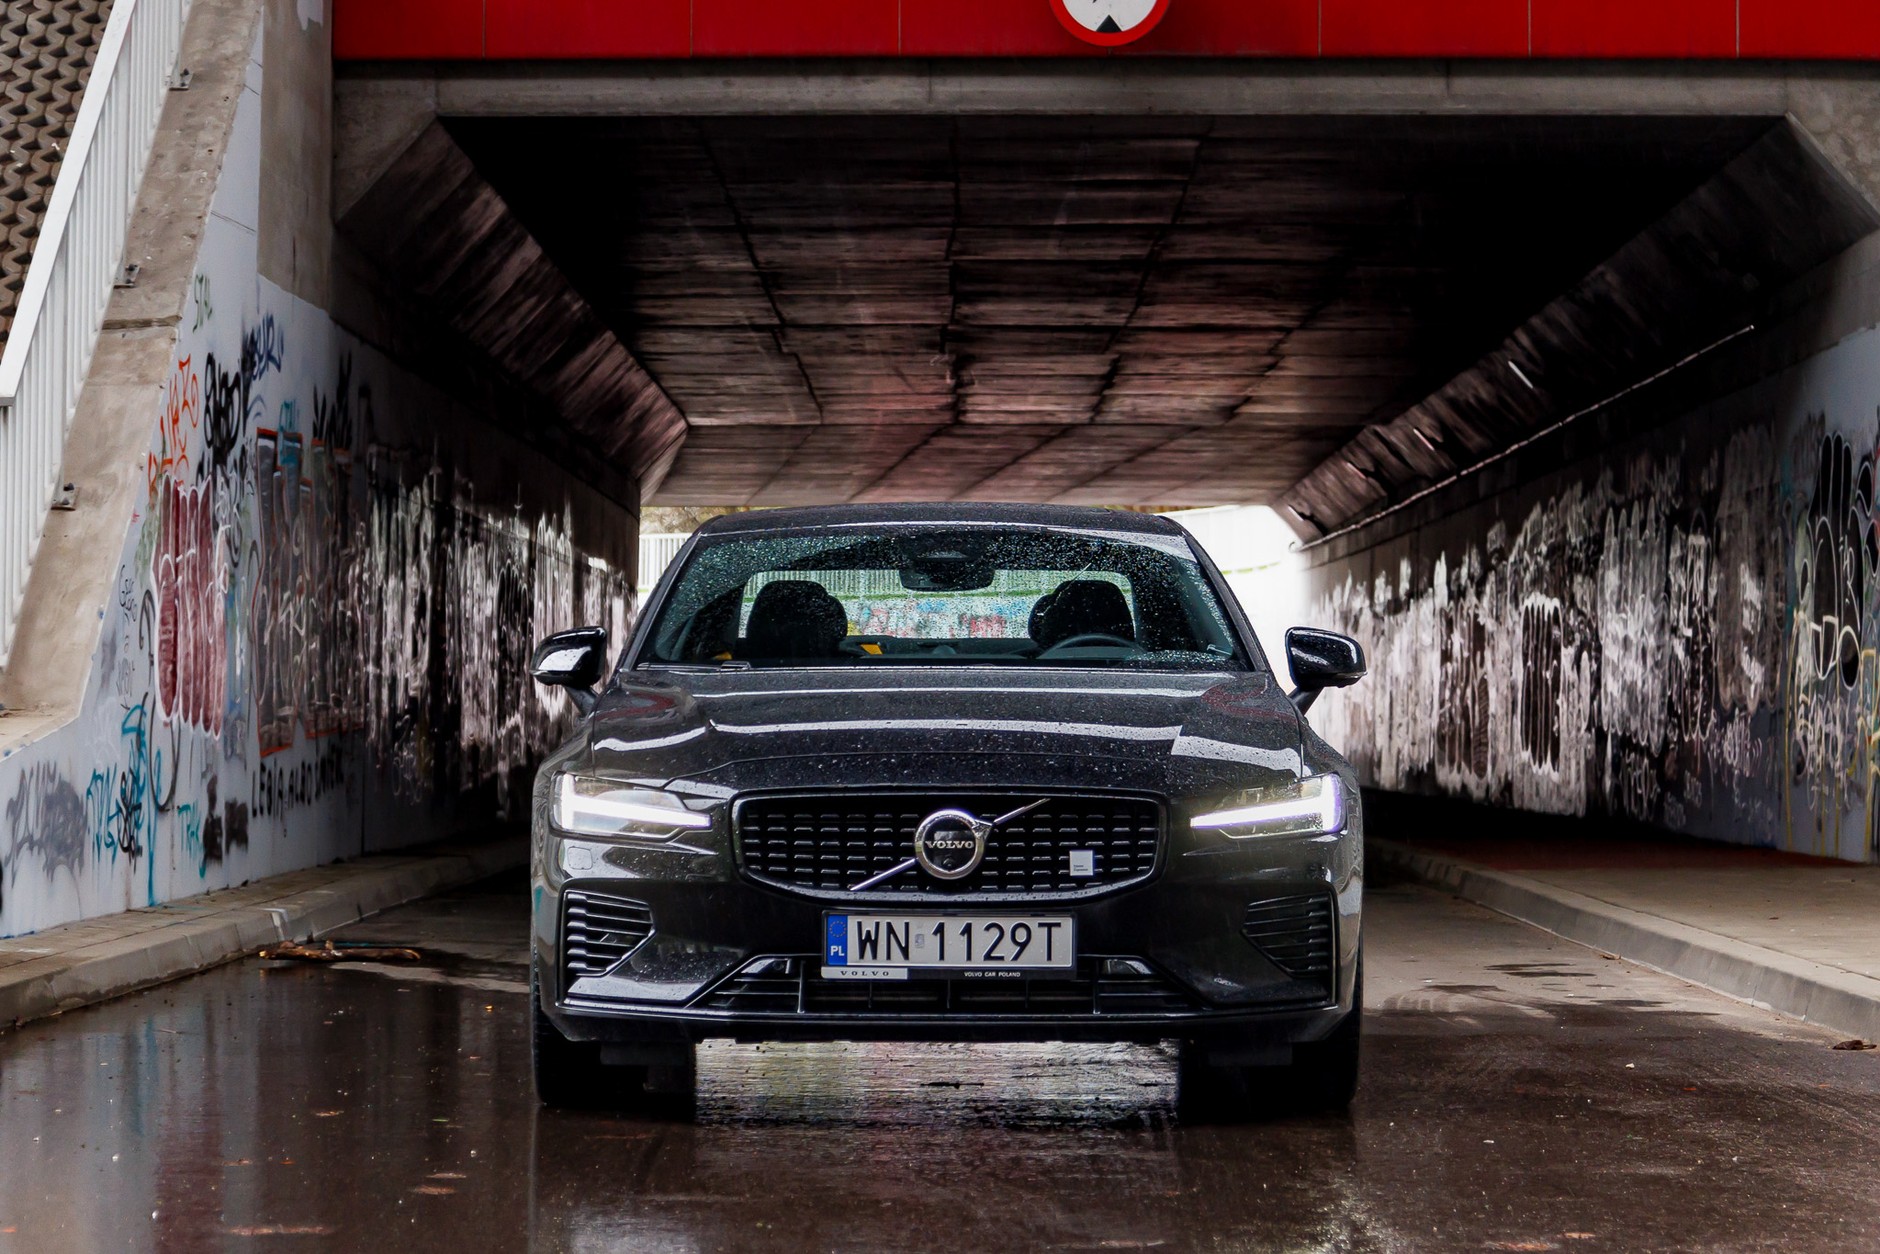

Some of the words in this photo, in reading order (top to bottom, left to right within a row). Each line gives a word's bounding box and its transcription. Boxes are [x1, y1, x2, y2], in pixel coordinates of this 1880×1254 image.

[924, 840, 975, 849] VOLVO
[856, 920, 910, 961] WN
[932, 921, 1062, 962] 1129T
[830, 945, 845, 957] PL
